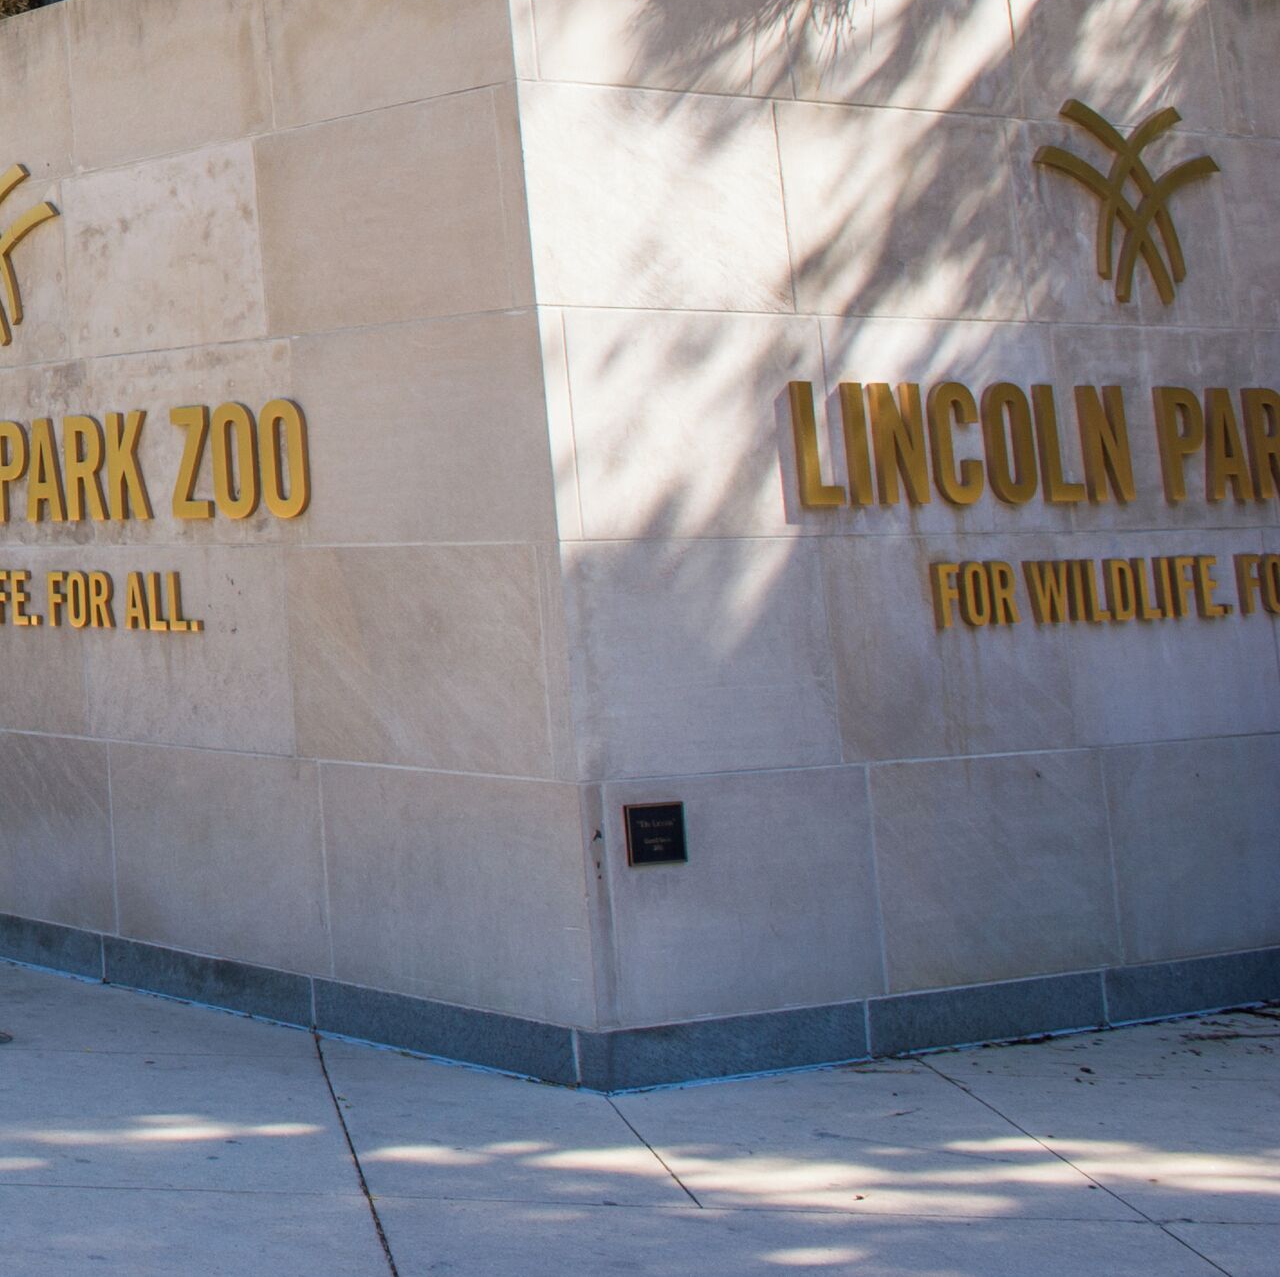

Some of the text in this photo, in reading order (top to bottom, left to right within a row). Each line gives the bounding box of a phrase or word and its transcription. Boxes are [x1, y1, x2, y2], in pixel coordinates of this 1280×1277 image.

[169, 398, 312, 521] ZOO
[789, 381, 1137, 505] LINCOLN
[47, 570, 117, 629] FOR
[125, 570, 205, 633] ALL.
[930, 560, 1021, 628] FOR
[1021, 555, 1233, 626] WILDLIFE.
